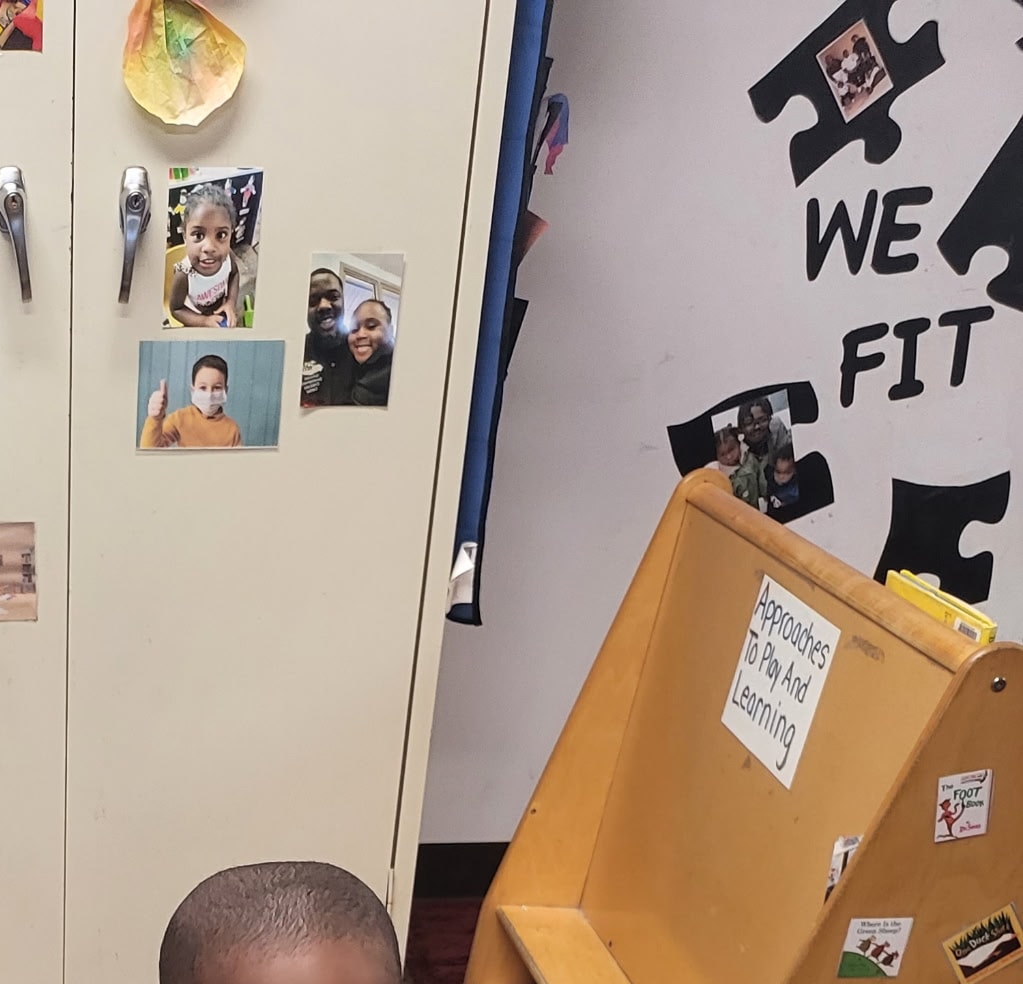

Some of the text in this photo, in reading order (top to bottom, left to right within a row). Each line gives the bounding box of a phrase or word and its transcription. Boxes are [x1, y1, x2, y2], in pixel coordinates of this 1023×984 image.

[806, 186, 933, 281] WE
[840, 305, 995, 408] FIT
[744, 629, 812, 704] To Play And
[754, 582, 830, 670] Approaches
[732, 669, 796, 771] Learning
[953, 786, 983, 800] FOOT
